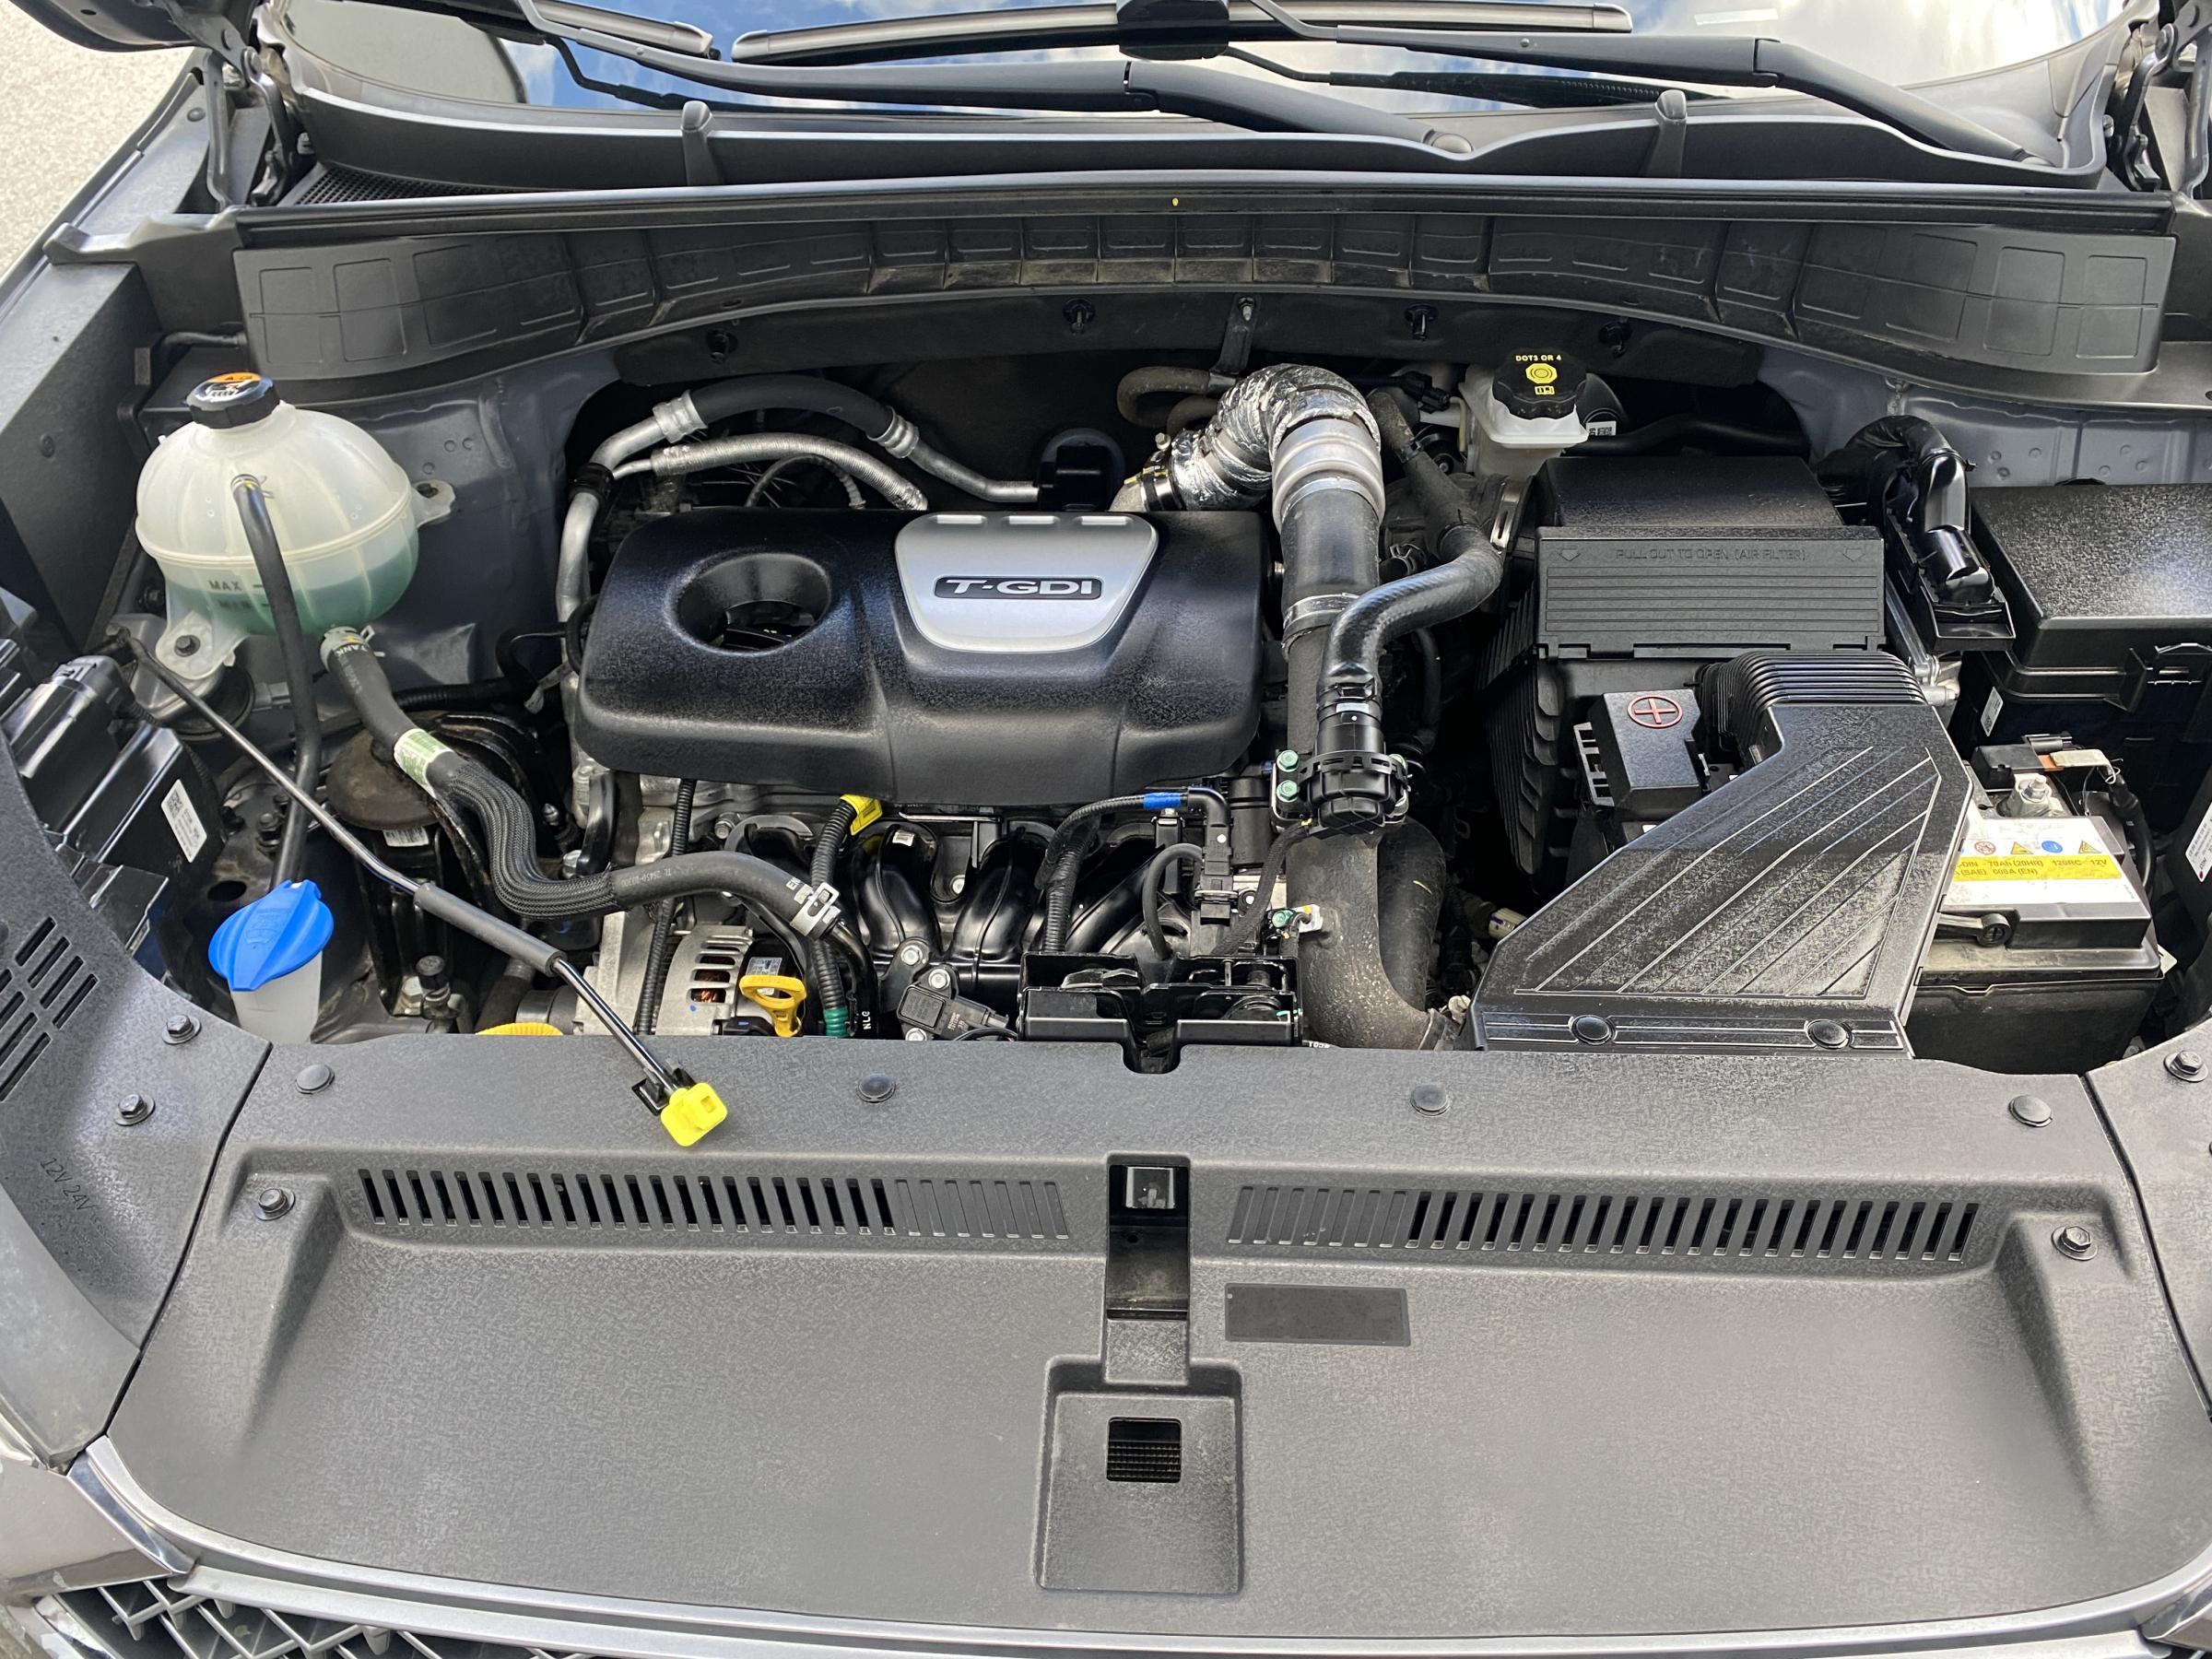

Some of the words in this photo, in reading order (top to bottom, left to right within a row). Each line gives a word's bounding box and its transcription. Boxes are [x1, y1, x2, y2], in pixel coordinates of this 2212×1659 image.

[1616, 548, 1647, 559] PULL
[1650, 548, 1675, 559] OUT
[1677, 548, 1693, 559] TO
[1696, 548, 1729, 559] OPEN
[207, 579, 242, 591] MAX
[946, 579, 1092, 594] T-GDI
[335, 644, 369, 657] TANK
[2089, 858, 2108, 866] 12V
[41, 1157, 72, 1182] 12V
[63, 1184, 98, 1210] 24V
